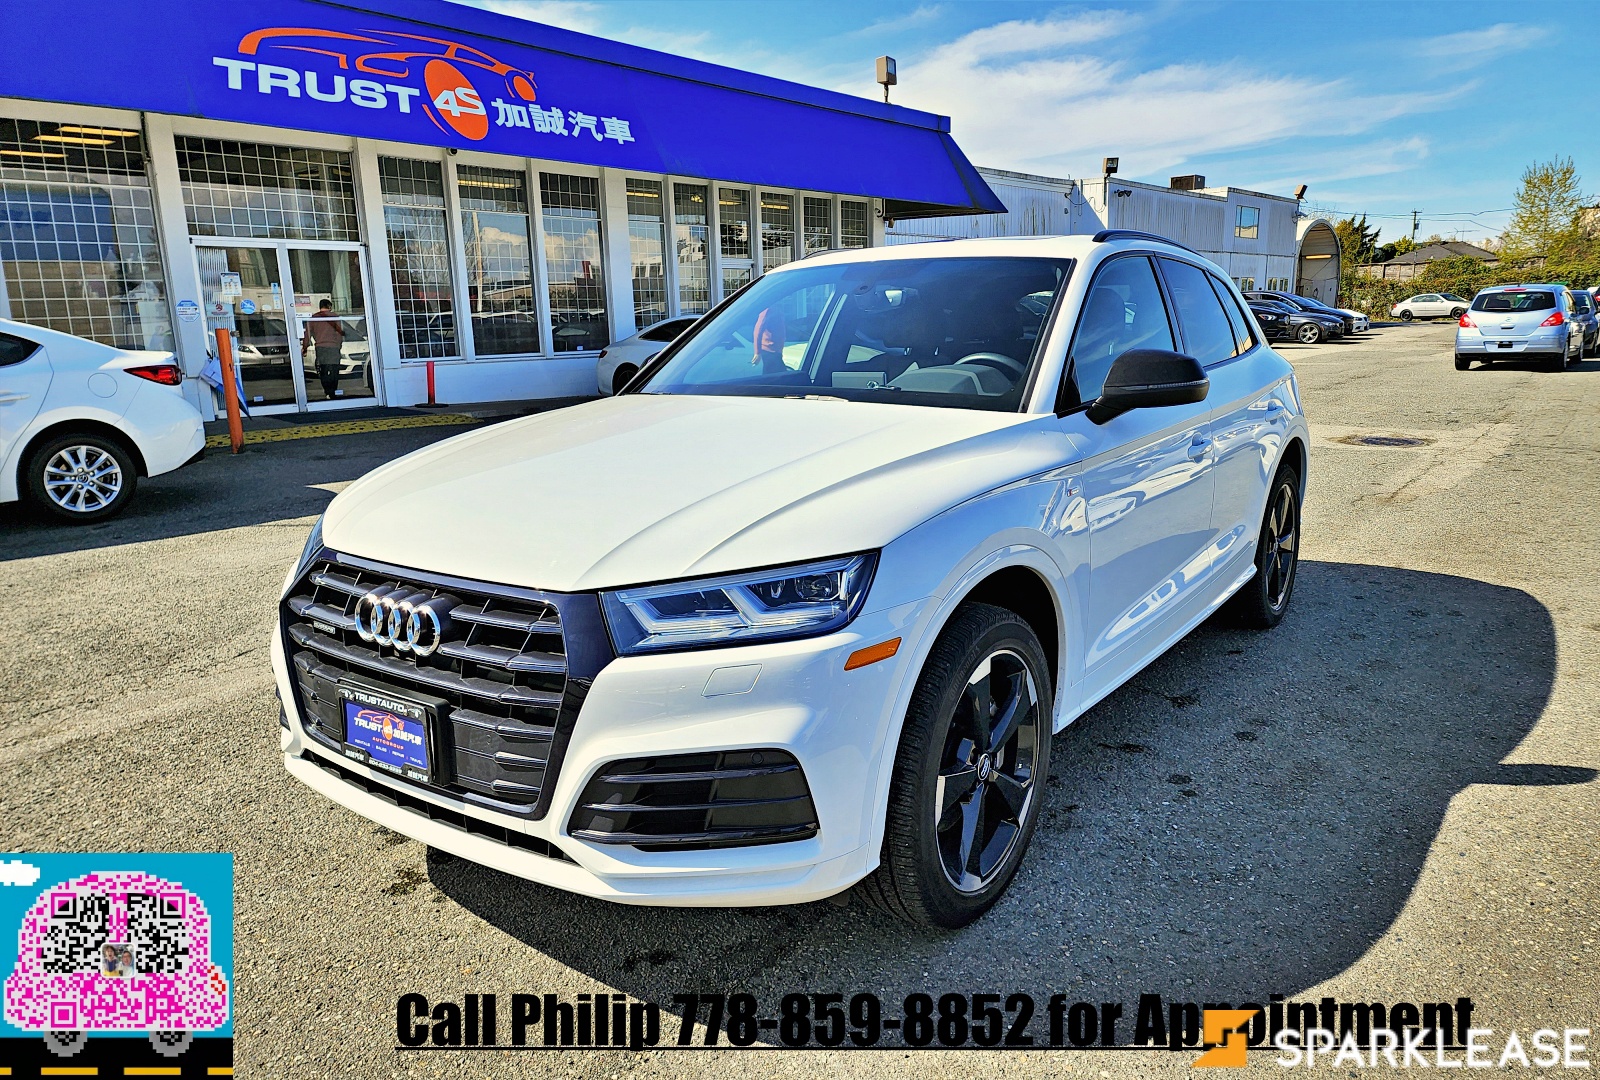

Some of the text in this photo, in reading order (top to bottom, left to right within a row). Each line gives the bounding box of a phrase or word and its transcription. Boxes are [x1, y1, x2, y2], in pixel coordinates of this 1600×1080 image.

[212, 56, 486, 118] TRUST 4S
[492, 97, 636, 145] 加誠汽車
[354, 692, 404, 712] TRUSTAUTO
[354, 717, 383, 732] TRUST
